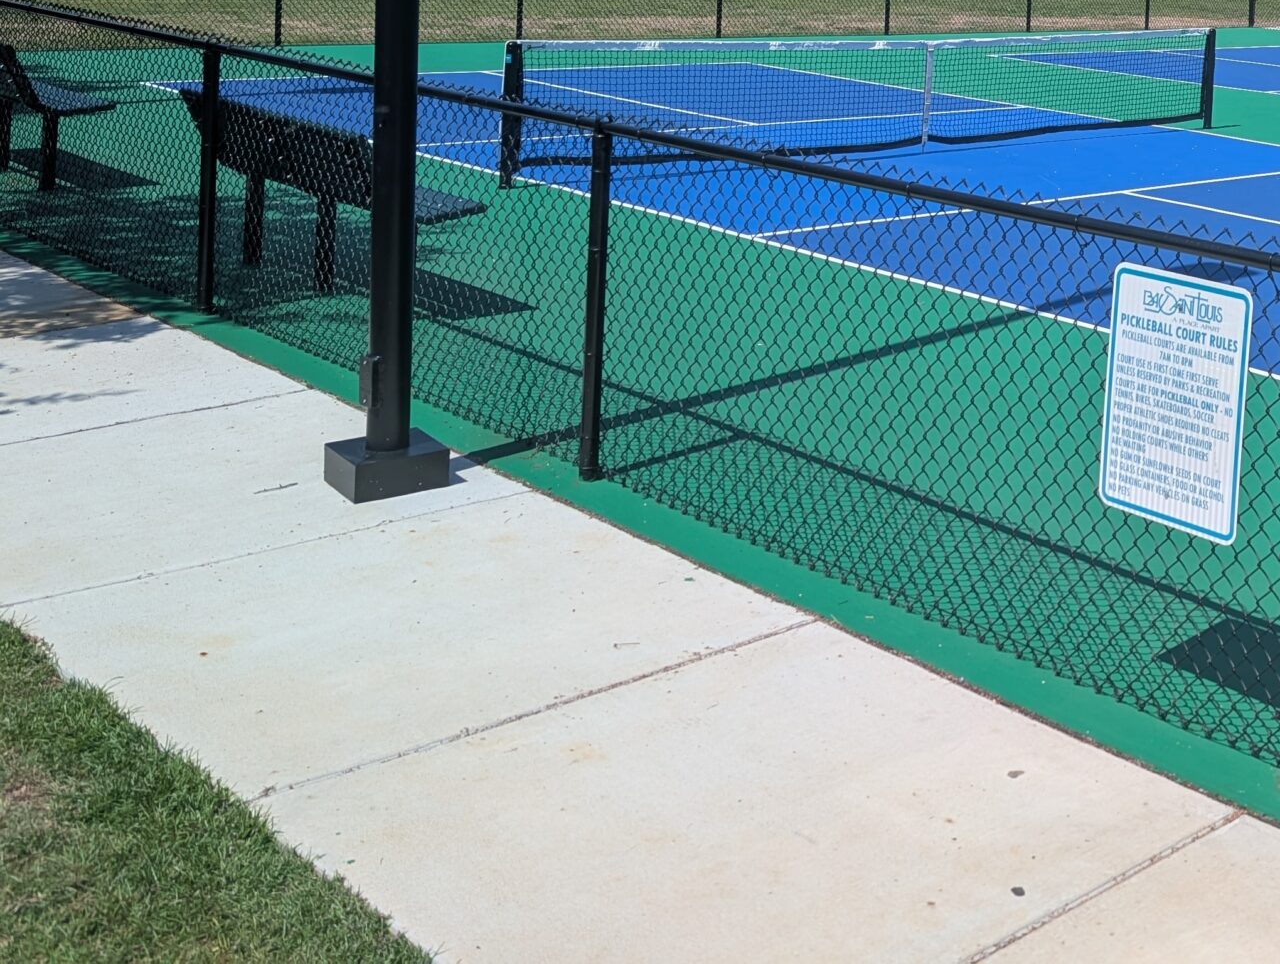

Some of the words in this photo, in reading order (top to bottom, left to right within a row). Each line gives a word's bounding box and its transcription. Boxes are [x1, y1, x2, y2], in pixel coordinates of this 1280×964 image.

[1196, 292, 1223, 324] LOUIS
[1121, 313, 1172, 336] PICKLEBALL
[1176, 327, 1207, 345] COURT
[1210, 335, 1238, 353] RULES
[1122, 329, 1152, 345] PICKLEBALL
[1154, 338, 1174, 350] COURTS
[1176, 343, 1186, 354] ARE
[1188, 346, 1217, 362] AVAILABLE
[1218, 355, 1234, 366] FROM
[1117, 353, 1134, 364] COURT
[1136, 357, 1146, 368] USE
[1148, 360, 1152, 369] IS
[1154, 362, 1168, 373] FIRST
[1169, 365, 1185, 378] COME
[1186, 370, 1201, 382] FIRST
[1202, 374, 1218, 388] SERVE
[1160, 351, 1171, 361] 7AM
[1173, 354, 1179, 364] TO
[1181, 356, 1193, 368] 8PM
[1116, 377, 1135, 390] COURTS
[1136, 383, 1147, 393] ARE
[1148, 385, 1159, 396] FOR
[1161, 389, 1199, 408] PICKLEBALL
[1201, 399, 1218, 413] ONLY
[1225, 406, 1233, 418] NO
[1117, 364, 1135, 377] UNLESS
[1137, 370, 1162, 385] RESERVED
[1164, 376, 1170, 386] BY
[1172, 379, 1188, 391] PARKS
[1190, 384, 1195, 392] &
[1197, 385, 1230, 402] RECREATION
[1113, 414, 1120, 424] NO
[1122, 417, 1151, 433] PROFANITY
[1152, 424, 1159, 434] OR
[1161, 428, 1183, 442] ABUSIVE
[1185, 435, 1212, 451] BEHAVIOR
[1114, 400, 1132, 414] PROPER
[1134, 405, 1156, 421] ATHLETIC
[1158, 412, 1173, 426] SHOES
[1175, 418, 1200, 432] REQUIRED
[1202, 425, 1210, 435] NO
[1211, 428, 1229, 442] CLEATS
[1194, 410, 1214, 423] SOCCER
[1112, 426, 1120, 434] NO
[1122, 429, 1146, 444] HOLDING
[1147, 435, 1167, 450] COURTS
[1169, 442, 1186, 455] WHILE
[1188, 447, 1208, 462] OTHERS
[1112, 435, 1122, 446] ARE
[1123, 438, 1146, 453] WAITING
[1108, 482, 1116, 492] NO
[1110, 459, 1118, 469] NO
[1120, 461, 1136, 474] GLASS
[1173, 478, 1187, 491] FOOD
[1189, 484, 1197, 494] OR
[1199, 487, 1224, 503] ALCOHOL
[1111, 447, 1118, 458] NO
[1120, 450, 1133, 462] GUM
[1134, 455, 1141, 465] OR
[1143, 457, 1173, 475] SUNFLOWER
[1176, 468, 1192, 480] SEEDS
[1193, 472, 1202, 482] ON
[1203, 475, 1221, 490] COURT
[1109, 470, 1117, 480] NO
[1119, 473, 1142, 488] PARKING
[1143, 481, 1154, 492] ANY
[1156, 484, 1180, 501] VEHICLES
[1181, 494, 1189, 503] ON
[1192, 496, 1208, 510] GRASS
